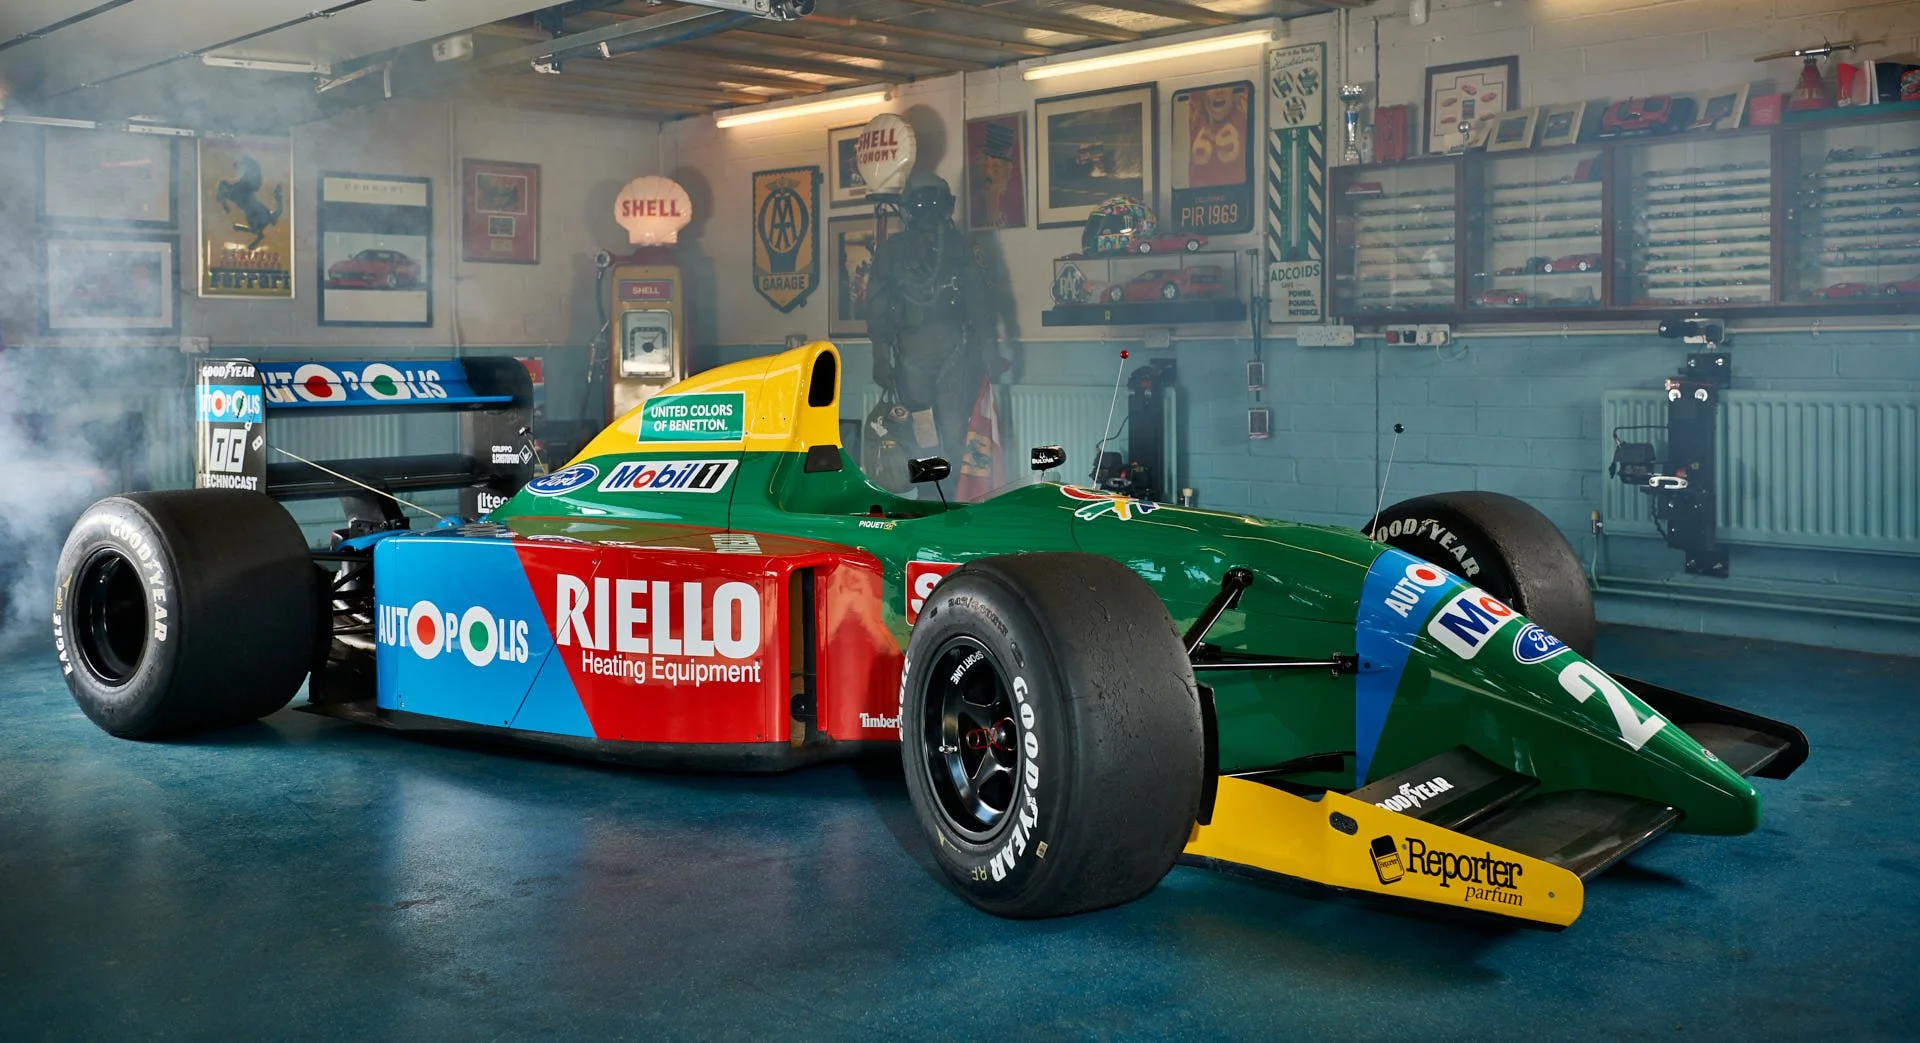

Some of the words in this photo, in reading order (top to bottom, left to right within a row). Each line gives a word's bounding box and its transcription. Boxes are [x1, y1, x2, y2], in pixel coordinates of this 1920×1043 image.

[1192, 123, 1240, 165] 69
[622, 200, 681, 217] SHELL
[1181, 206, 1205, 228] PIR
[1208, 203, 1238, 225] 1969
[762, 276, 805, 291] GARAGE
[1270, 263, 1320, 283] ADCOIDS
[632, 286, 661, 295] SHELL
[260, 363, 448, 403] UTOPOLIS
[651, 405, 688, 418] UNITED
[690, 404, 733, 416] COLORS
[654, 420, 668, 431] OF
[669, 418, 729, 431] BENETTON.
[202, 474, 257, 491] TECHNOCAST
[536, 470, 584, 487] Ford
[605, 463, 700, 489] Mobil
[859, 520, 885, 529] PIQUET
[1375, 517, 1481, 578] OODYEAR
[109, 522, 169, 643] GOODYEAR
[1384, 562, 1448, 619] AUTO
[556, 574, 761, 659] RIELLO
[1438, 596, 1512, 648] Mo
[52, 612, 74, 676] EAGLE
[378, 600, 529, 667] AUTOPOLIS
[582, 650, 646, 684] Heating
[651, 656, 761, 687] Equipment
[963, 650, 984, 670] SPORT
[950, 664, 968, 685] LINE
[1558, 661, 1667, 751] 2
[859, 713, 900, 728] Timberl
[990, 676, 1040, 882] GOODYEAR
[1405, 837, 1523, 889] Reporter
[1465, 885, 1524, 907] parfum
